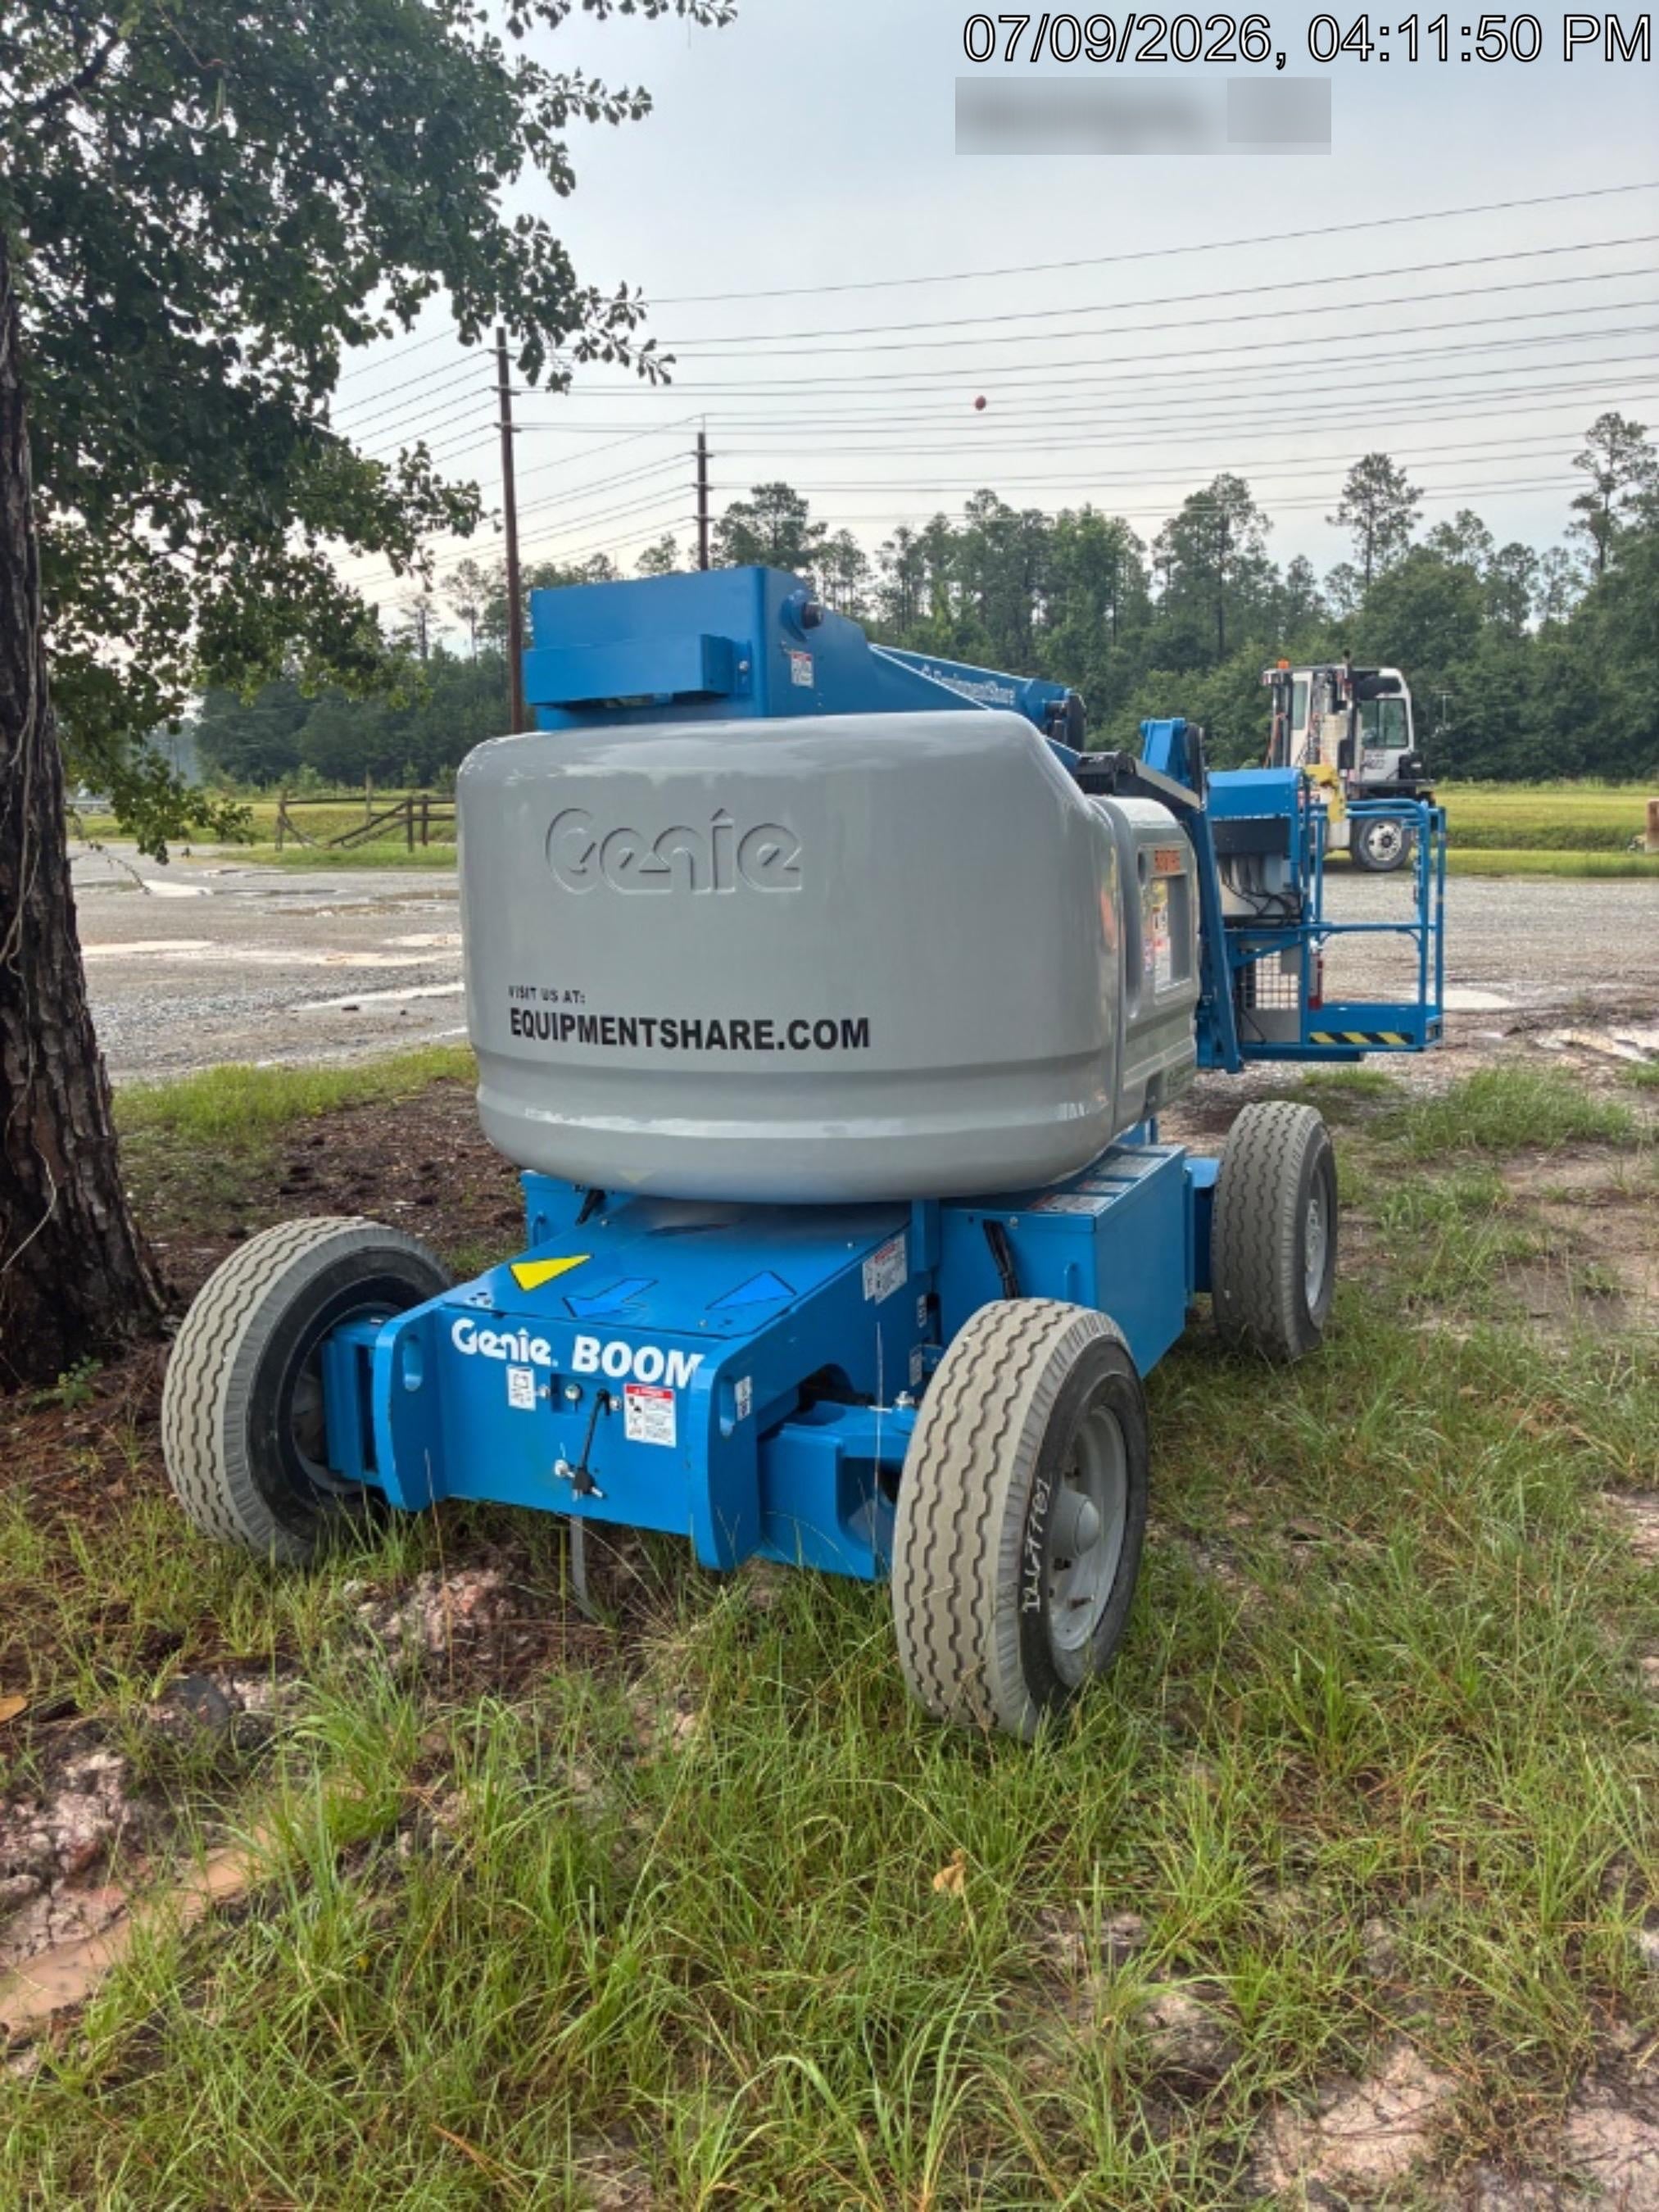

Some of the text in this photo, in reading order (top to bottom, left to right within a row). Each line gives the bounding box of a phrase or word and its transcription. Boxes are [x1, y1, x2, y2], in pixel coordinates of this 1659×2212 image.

[546, 808, 802, 895] Genie
[508, 986, 586, 1004] VISIT US AT:
[510, 1008, 869, 1050] EQUIPMENTSHARE.COM
[451, 1317, 552, 1367] Genie
